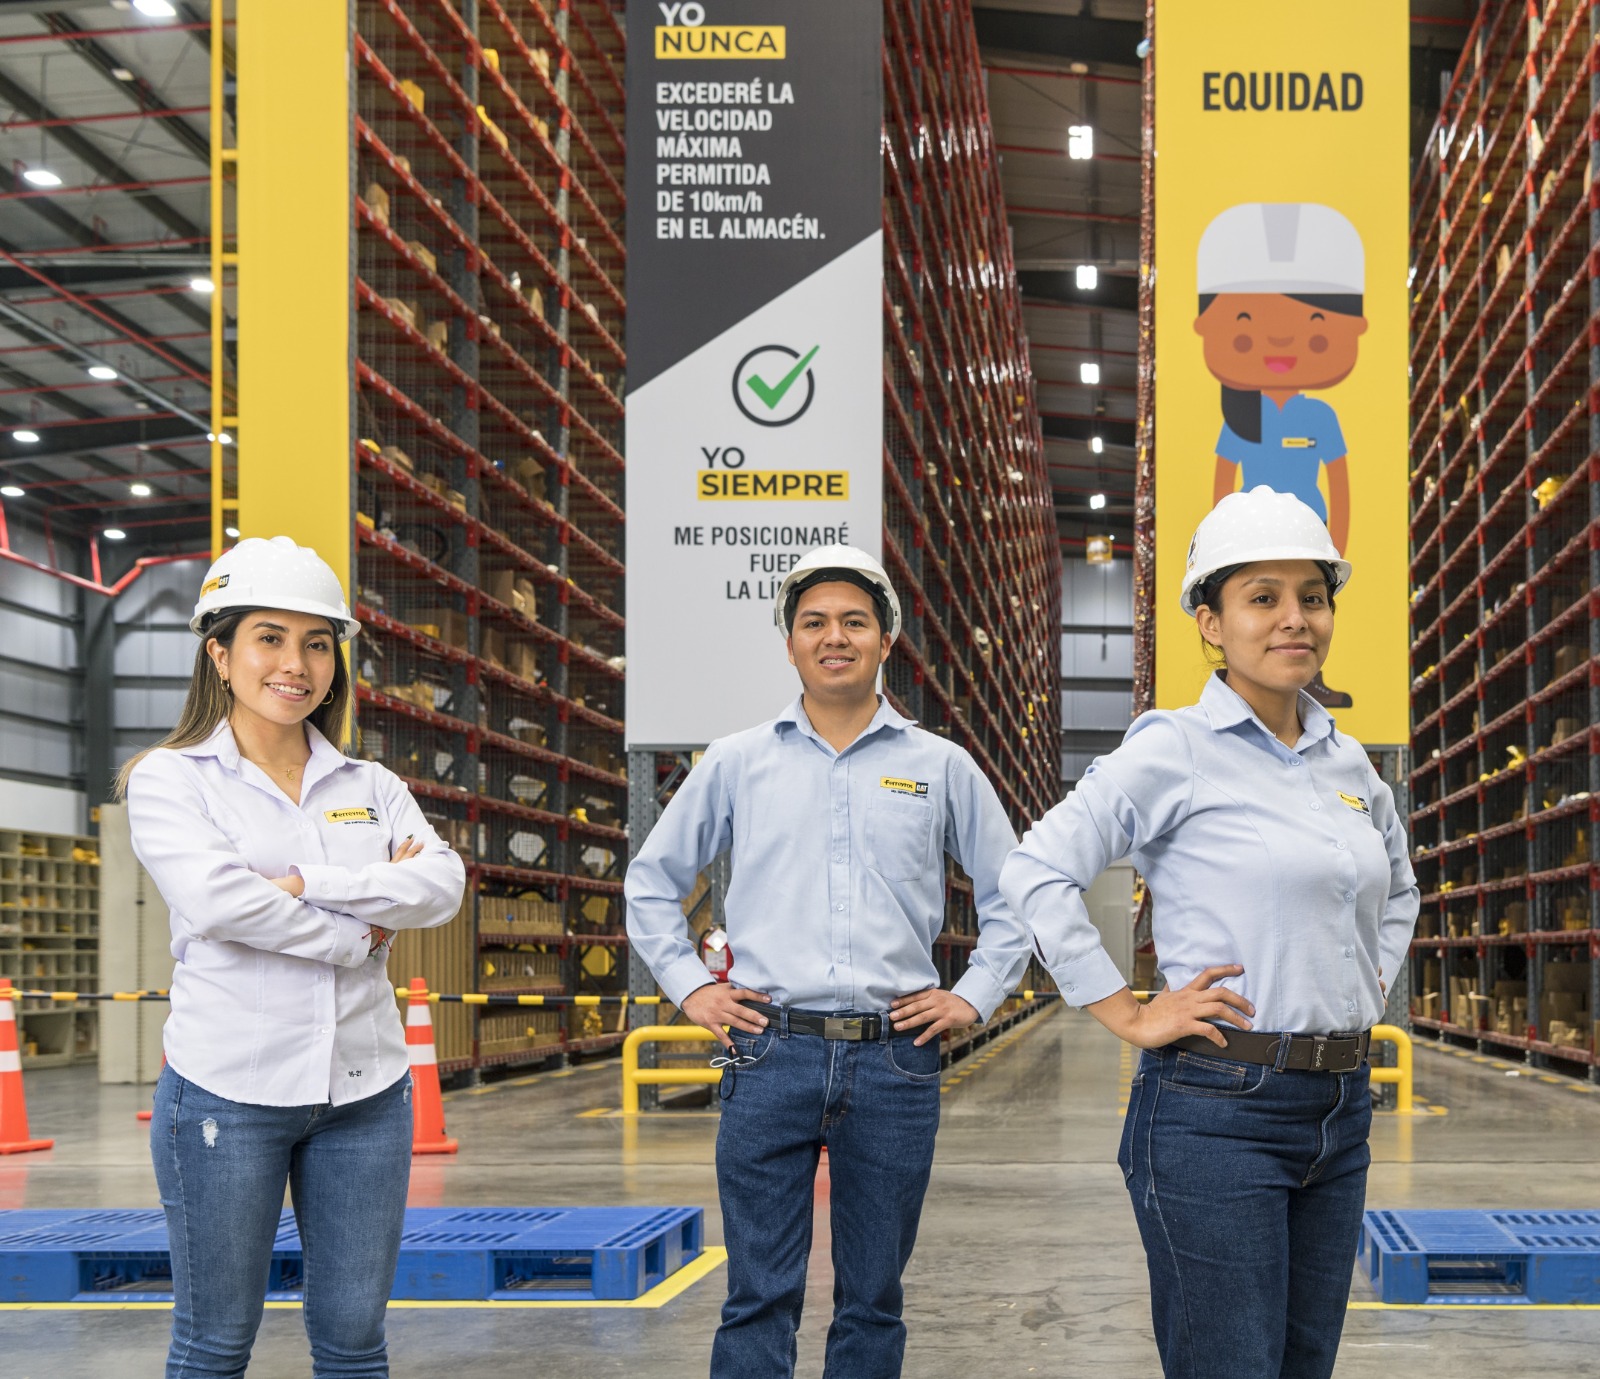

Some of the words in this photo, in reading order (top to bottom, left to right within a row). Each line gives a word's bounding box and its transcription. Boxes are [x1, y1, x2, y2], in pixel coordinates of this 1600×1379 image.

[658, 2, 706, 27] YO
[662, 30, 777, 53] NUNCA
[656, 77, 762, 104] EXCEDERÉ
[767, 82, 795, 104] LA
[1203, 72, 1364, 111] EQUIDAD
[656, 109, 773, 131] VELOCIDAD
[656, 131, 743, 158] MÁXIMA
[656, 163, 771, 185] PERMITIDA
[656, 190, 684, 212] DE
[689, 190, 763, 214] 10km/h
[656, 217, 684, 239] EN
[689, 217, 715, 239] EL
[719, 212, 826, 239] ALMACÉN.
[701, 446, 745, 469] YO
[702, 473, 844, 496] SIEMPRE
[674, 526, 704, 546] ME
[711, 522, 849, 546] POSICIONARÉ
[726, 581, 751, 600] LA
